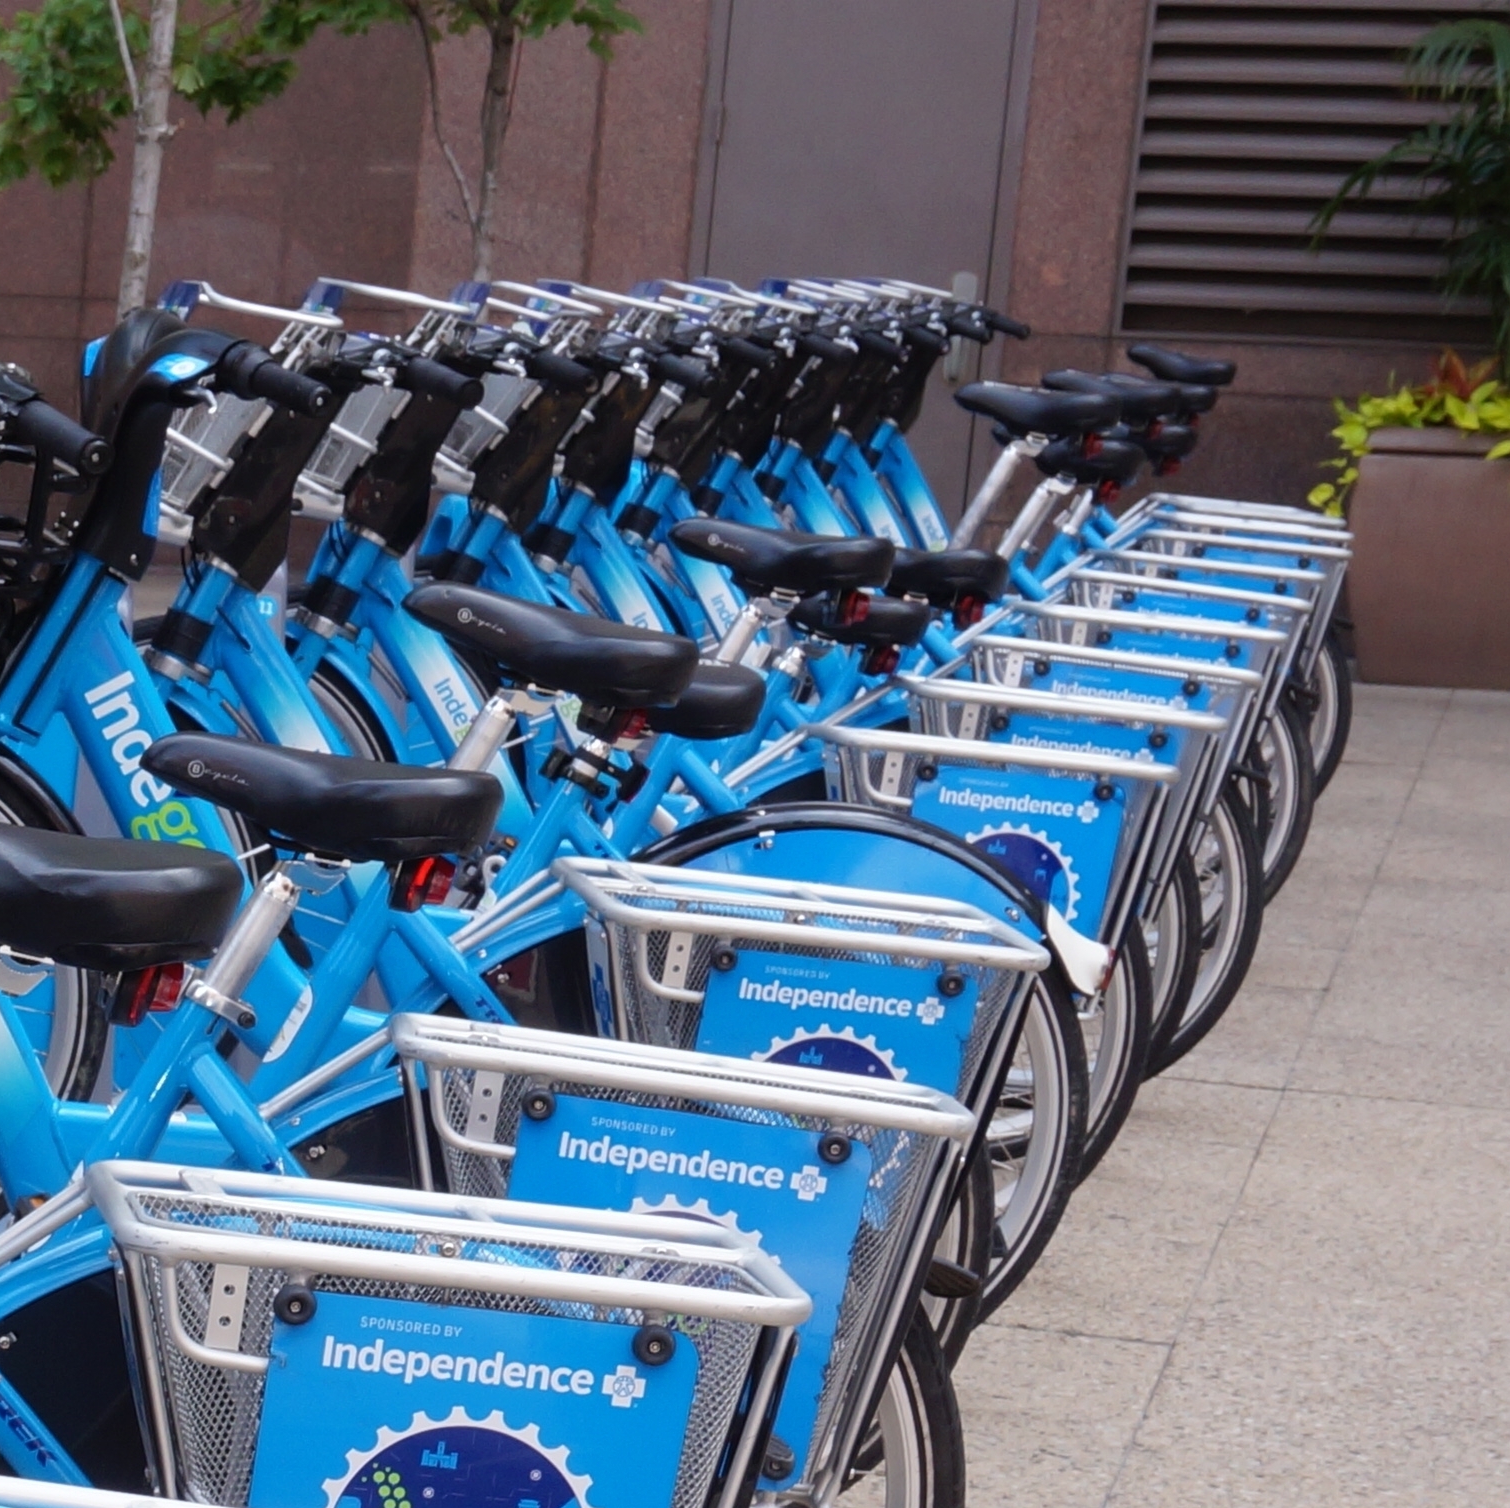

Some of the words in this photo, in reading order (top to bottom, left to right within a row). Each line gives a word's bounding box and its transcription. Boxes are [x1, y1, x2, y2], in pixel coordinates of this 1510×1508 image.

[84, 670, 207, 848] Indeg
[938, 785, 1075, 818] Independence
[738, 977, 913, 1017] Independence
[591, 1115, 658, 1136] SPONSORED
[659, 1126, 677, 1138] BY
[558, 1131, 785, 1189] Independence
[359, 1315, 441, 1337] SPONSORED
[443, 1324, 463, 1338] BY
[322, 1334, 595, 1396] Independence
